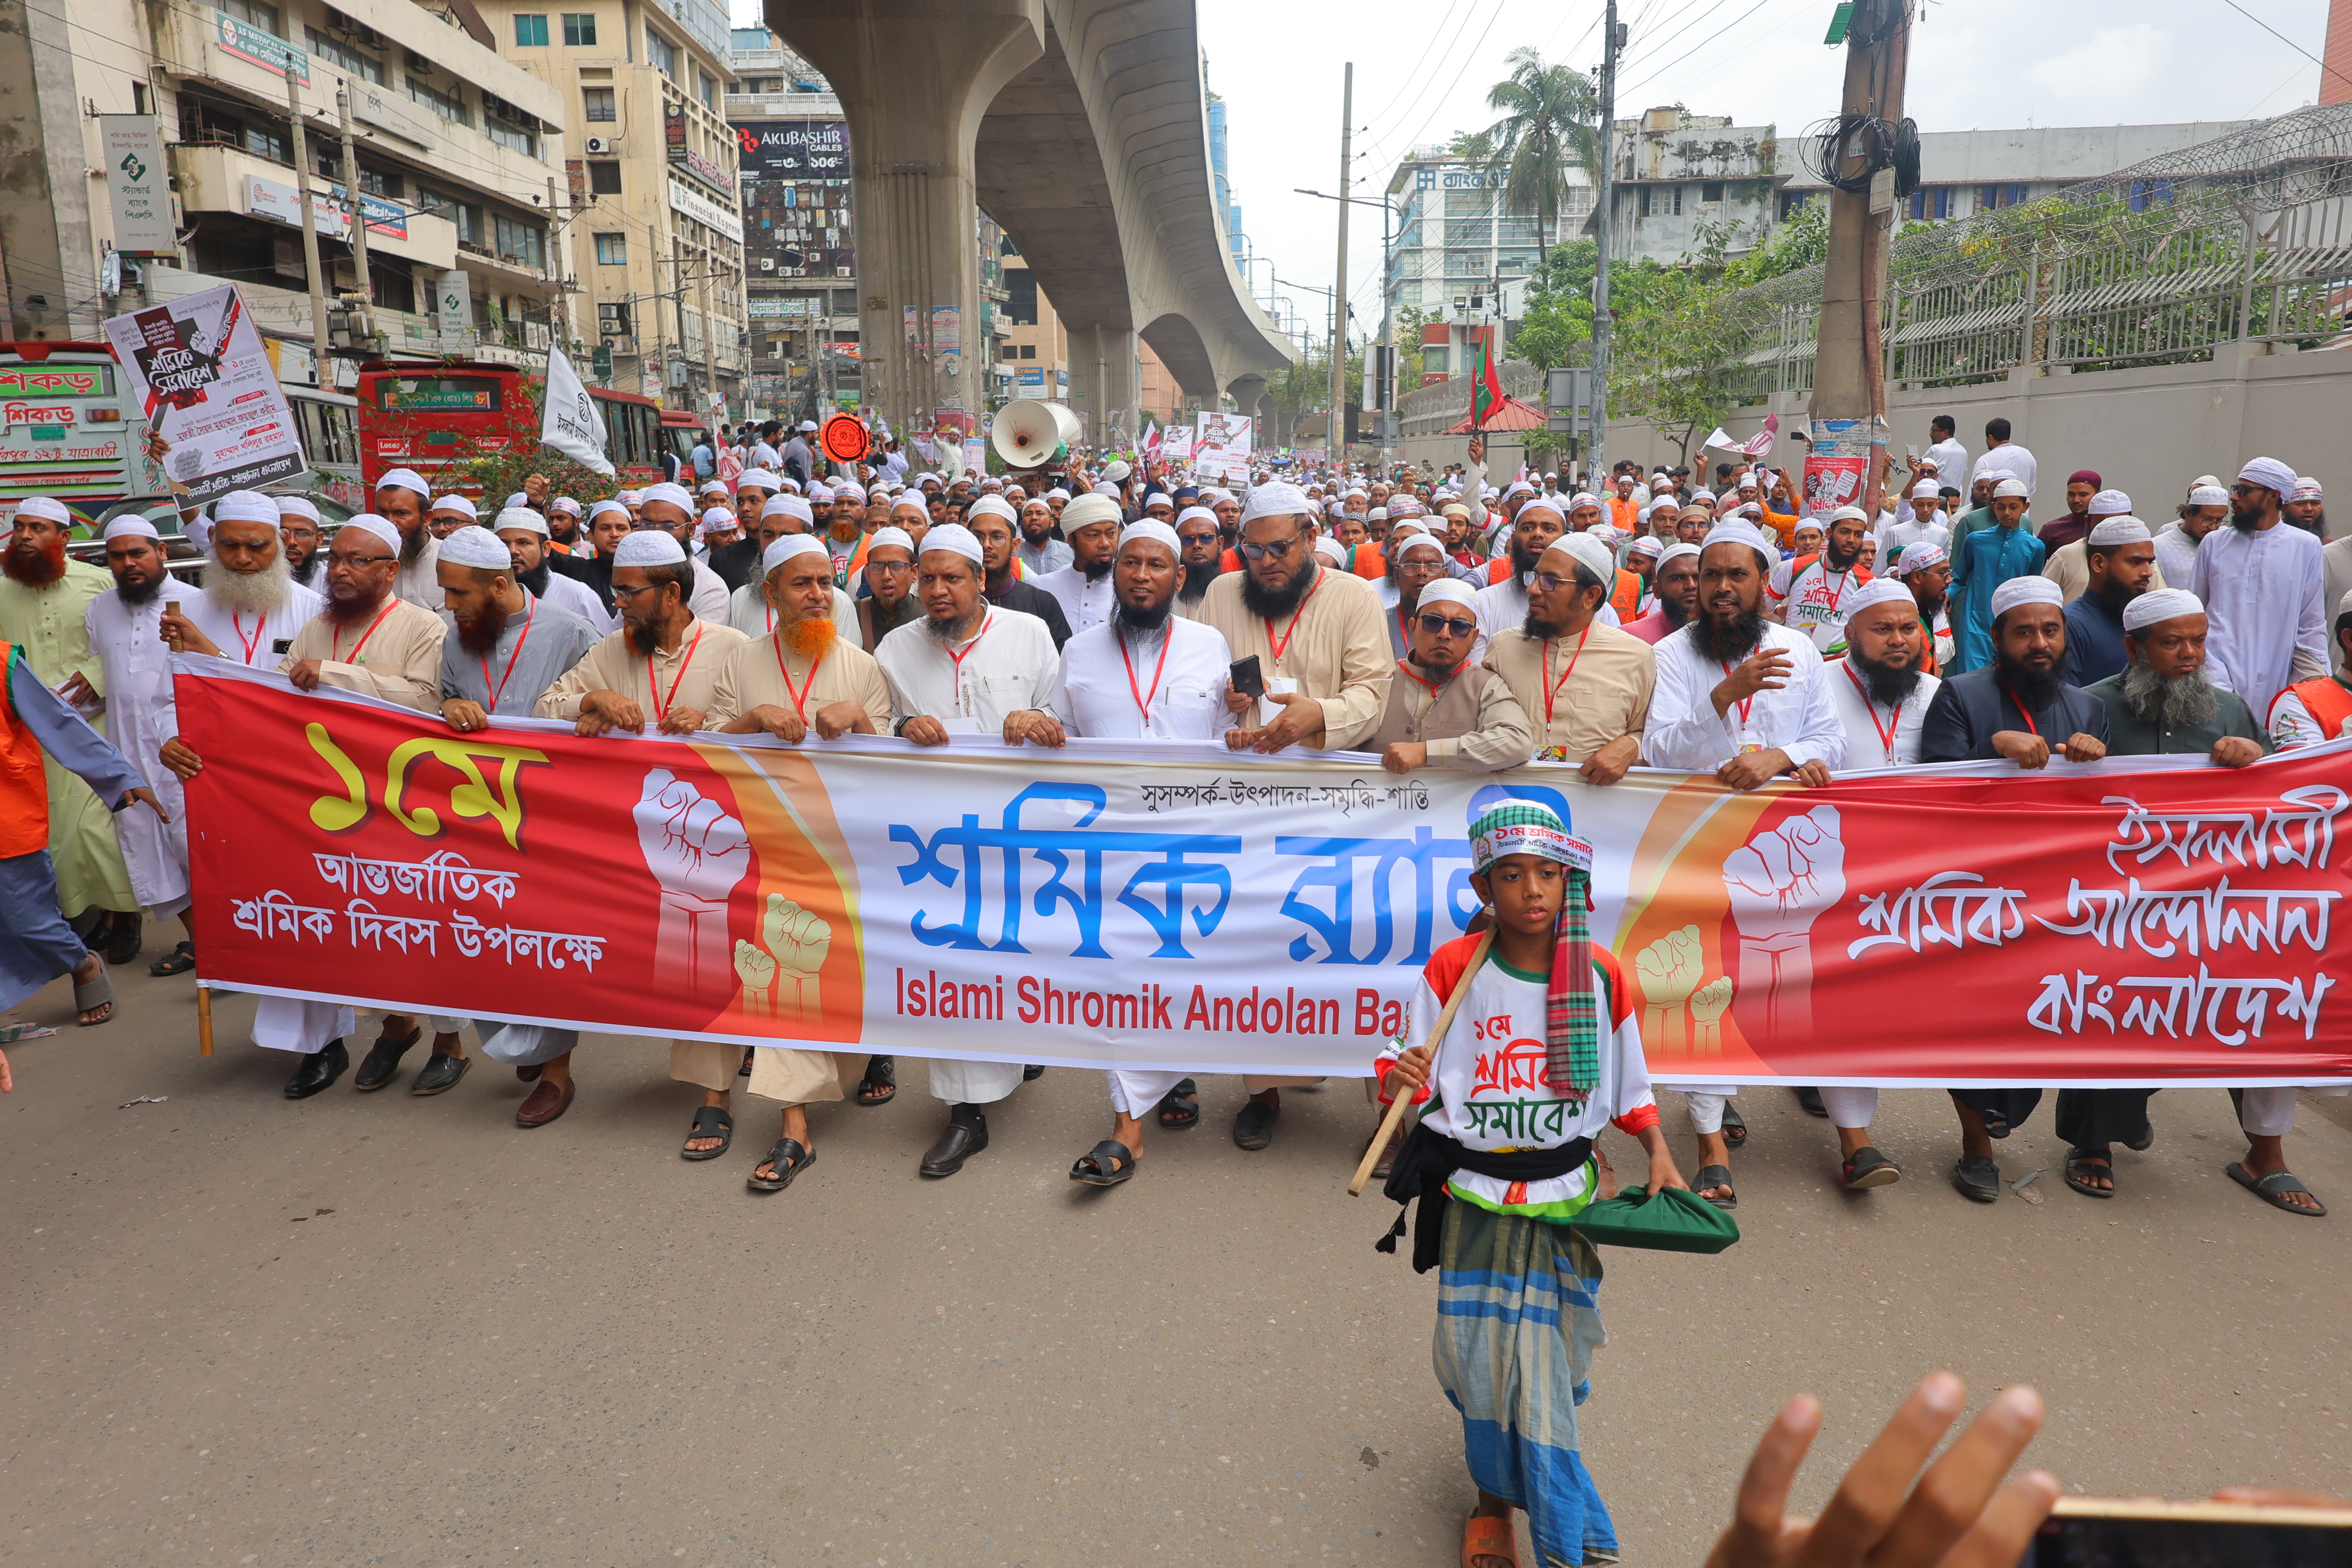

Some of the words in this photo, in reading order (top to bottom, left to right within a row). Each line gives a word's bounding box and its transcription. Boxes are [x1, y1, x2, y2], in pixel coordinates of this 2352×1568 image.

[239, 26, 247, 37] AF
[682, 194, 715, 220] Financial
[716, 211, 740, 236] Express
[751, 303, 778, 313] বিমান
[778, 302, 806, 313] টিকেট
[4, 402, 75, 429] শিকড়
[1496, 838, 1525, 850] ইসলামী
[1526, 839, 1549, 849] শ্রমিক
[1549, 844, 1578, 860] আন্দোলন
[1528, 827, 1564, 843] শ্রমিক
[2101, 783, 2351, 876] ইসলামী
[312, 849, 520, 909] আন্তর্জাতিক
[888, 781, 1242, 960] শ্রমিক
[1540, 850, 1563, 862] মহানগর
[231, 888, 335, 943] শ্রমিক
[346, 897, 441, 958] দিবস
[449, 906, 607, 973] উপলক্ষে
[1846, 870, 2027, 961] শ্রমিক
[2031, 874, 2343, 959] আন্দোলন
[896, 966, 1004, 1021] Islami
[1017, 974, 1172, 1031] Shromik
[1184, 986, 1340, 1037] Andolan
[2026, 961, 2337, 1047] বাংলাদেশ
